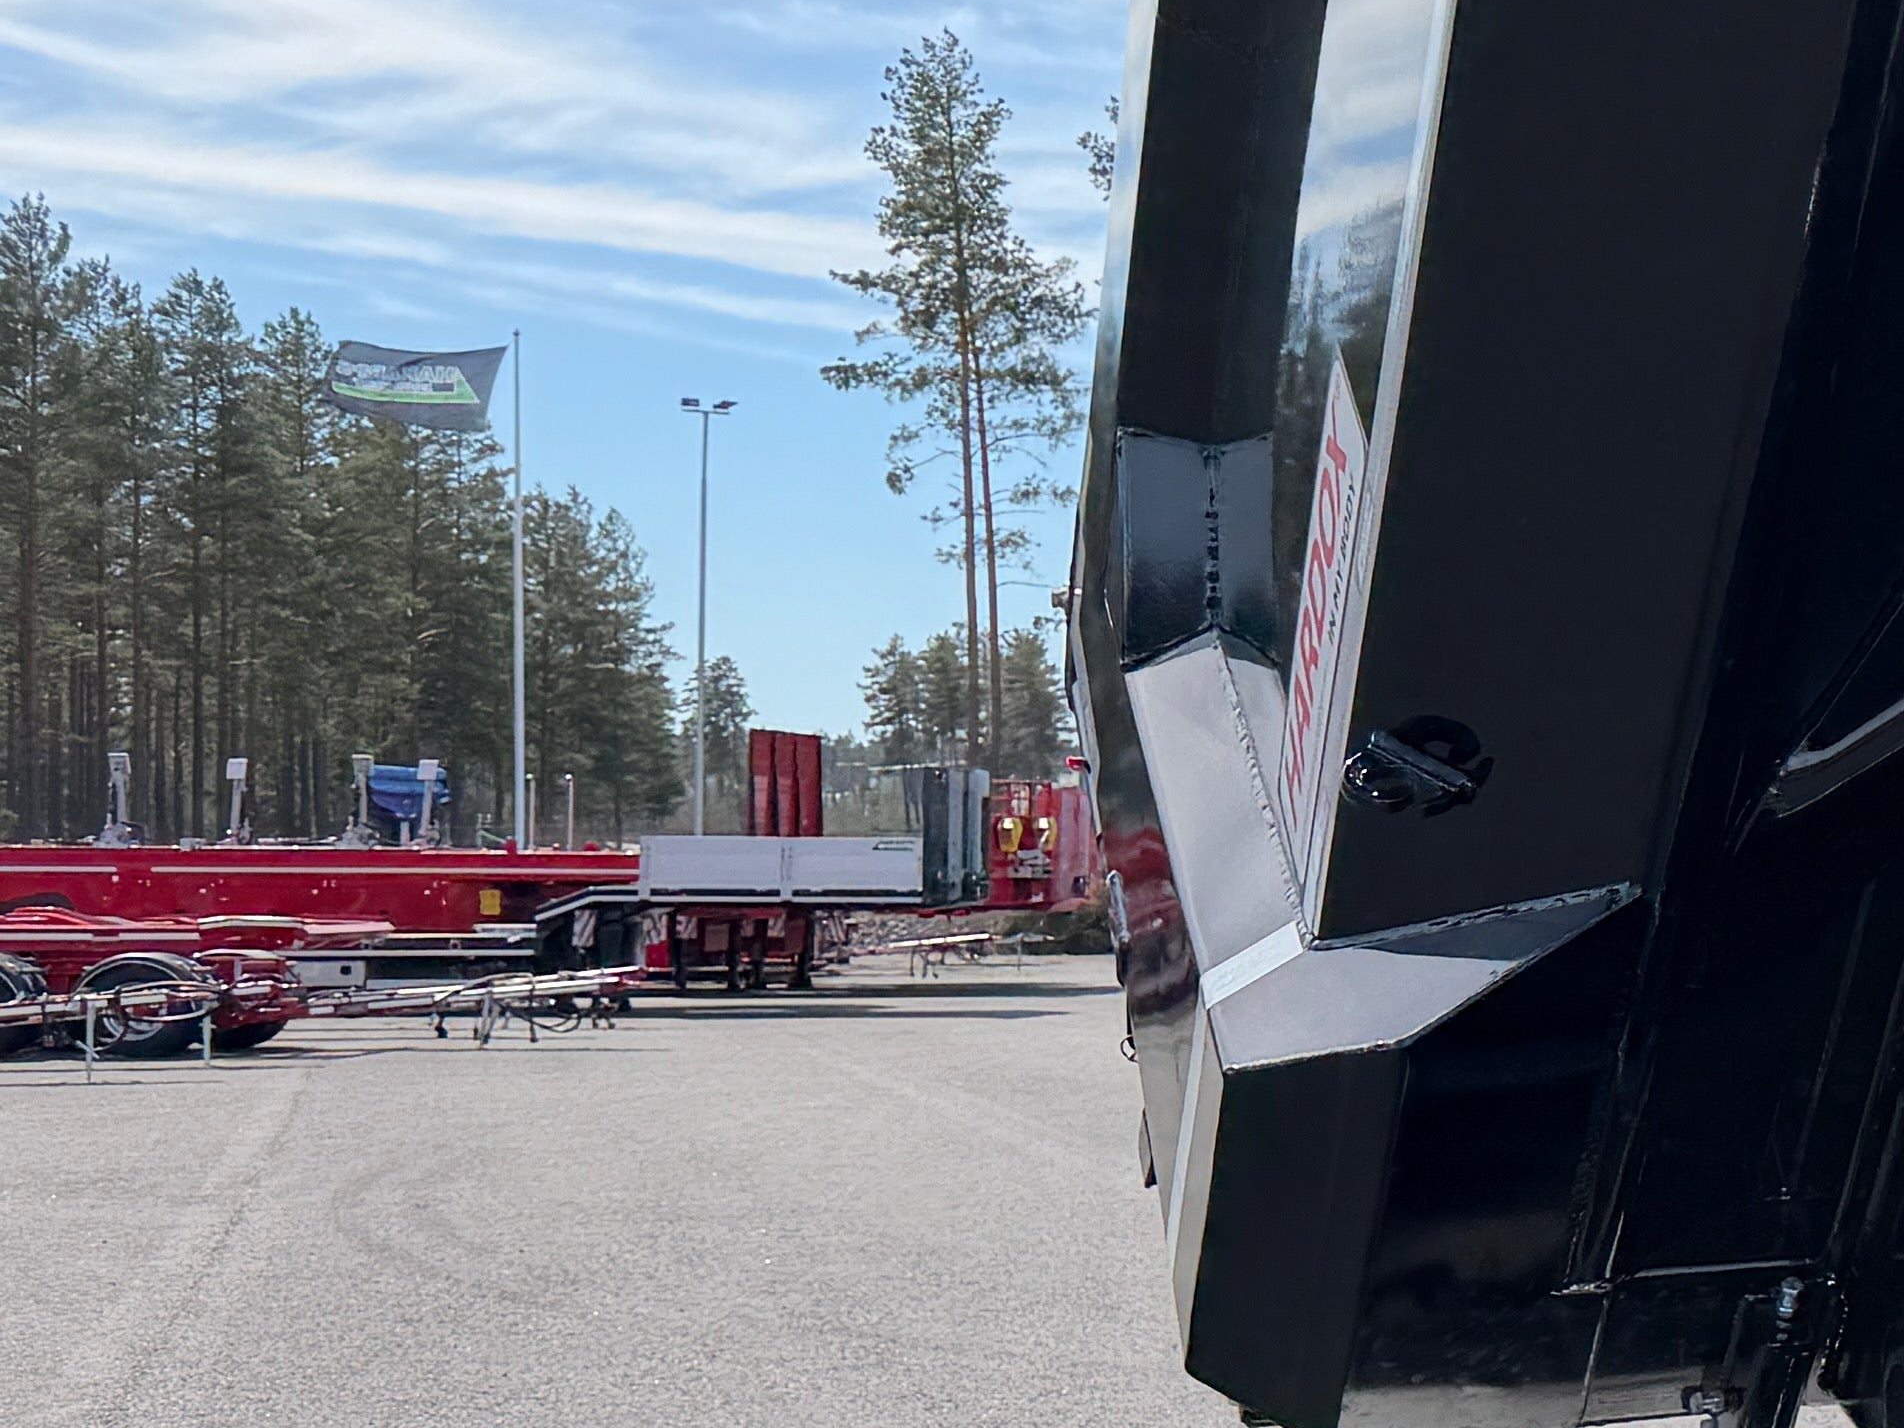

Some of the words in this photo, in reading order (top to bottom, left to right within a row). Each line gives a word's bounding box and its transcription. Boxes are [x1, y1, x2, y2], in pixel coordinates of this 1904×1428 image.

[1285, 400, 1347, 832] HARDOX
[1328, 610, 1337, 645] IN
[1333, 561, 1343, 612] MY
[1339, 473, 1355, 562] BODY
